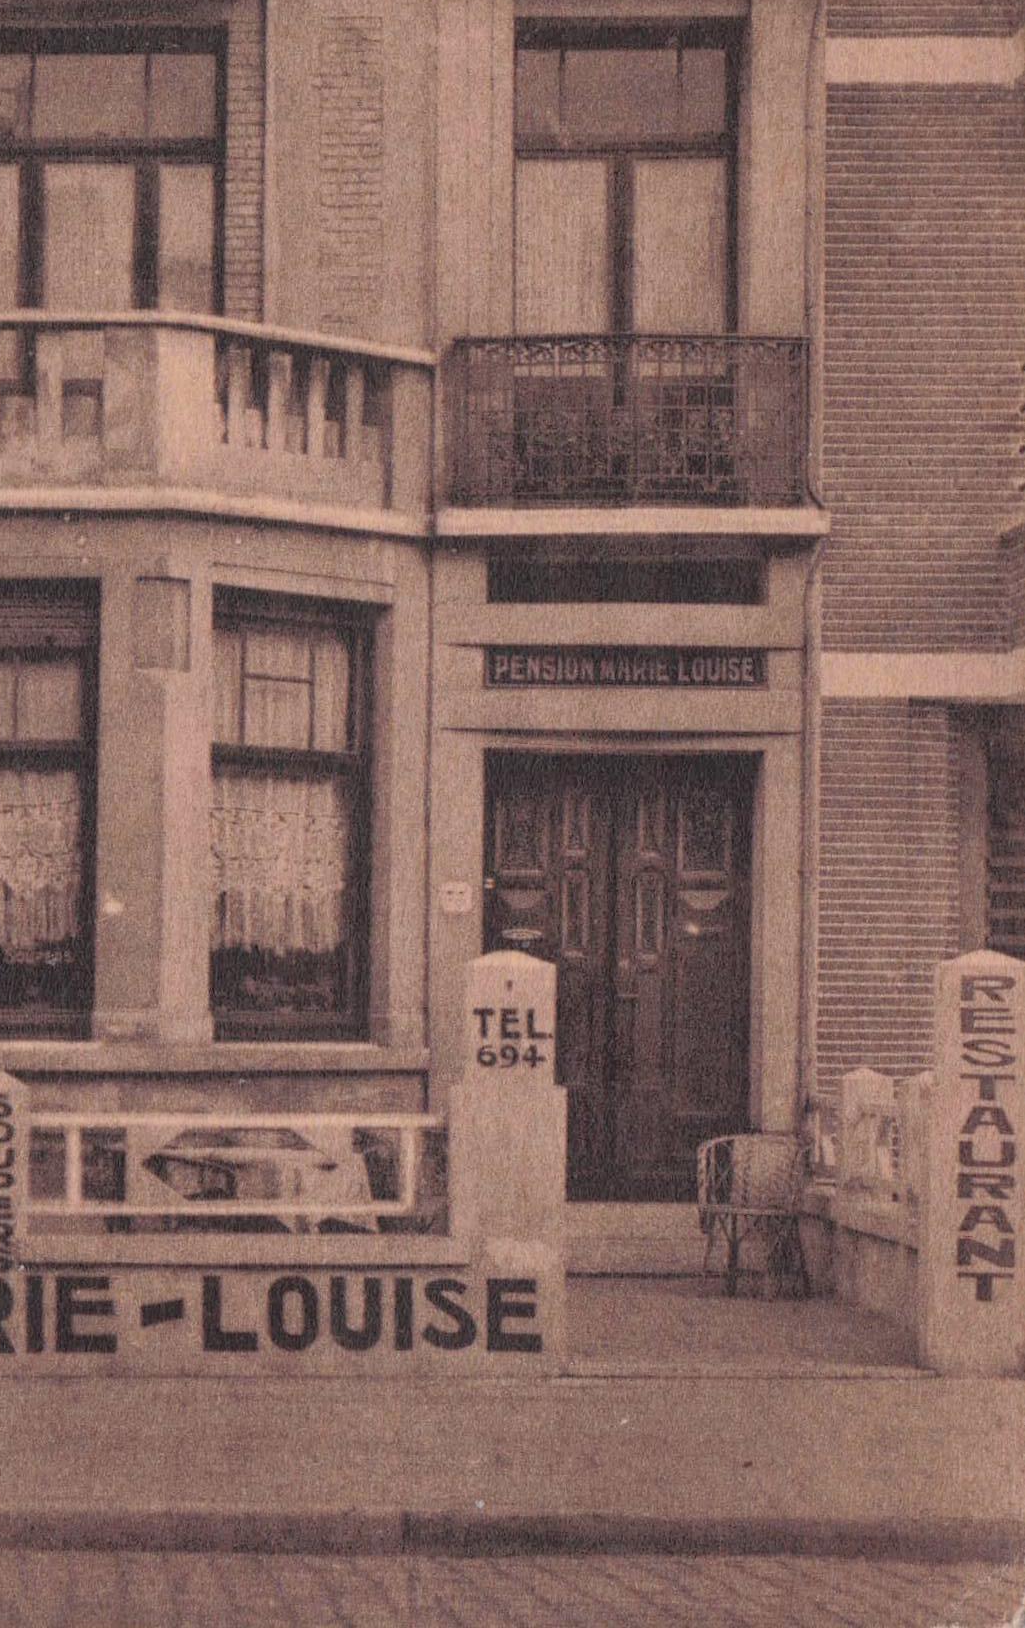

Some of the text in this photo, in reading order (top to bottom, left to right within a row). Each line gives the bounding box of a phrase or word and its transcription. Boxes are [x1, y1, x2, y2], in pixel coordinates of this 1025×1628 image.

[494, 654, 594, 683] PENSION
[678, 656, 755, 684] LOUISE
[476, 1043, 547, 1069] 694
[956, 975, 1017, 1302] RESTAURANT
